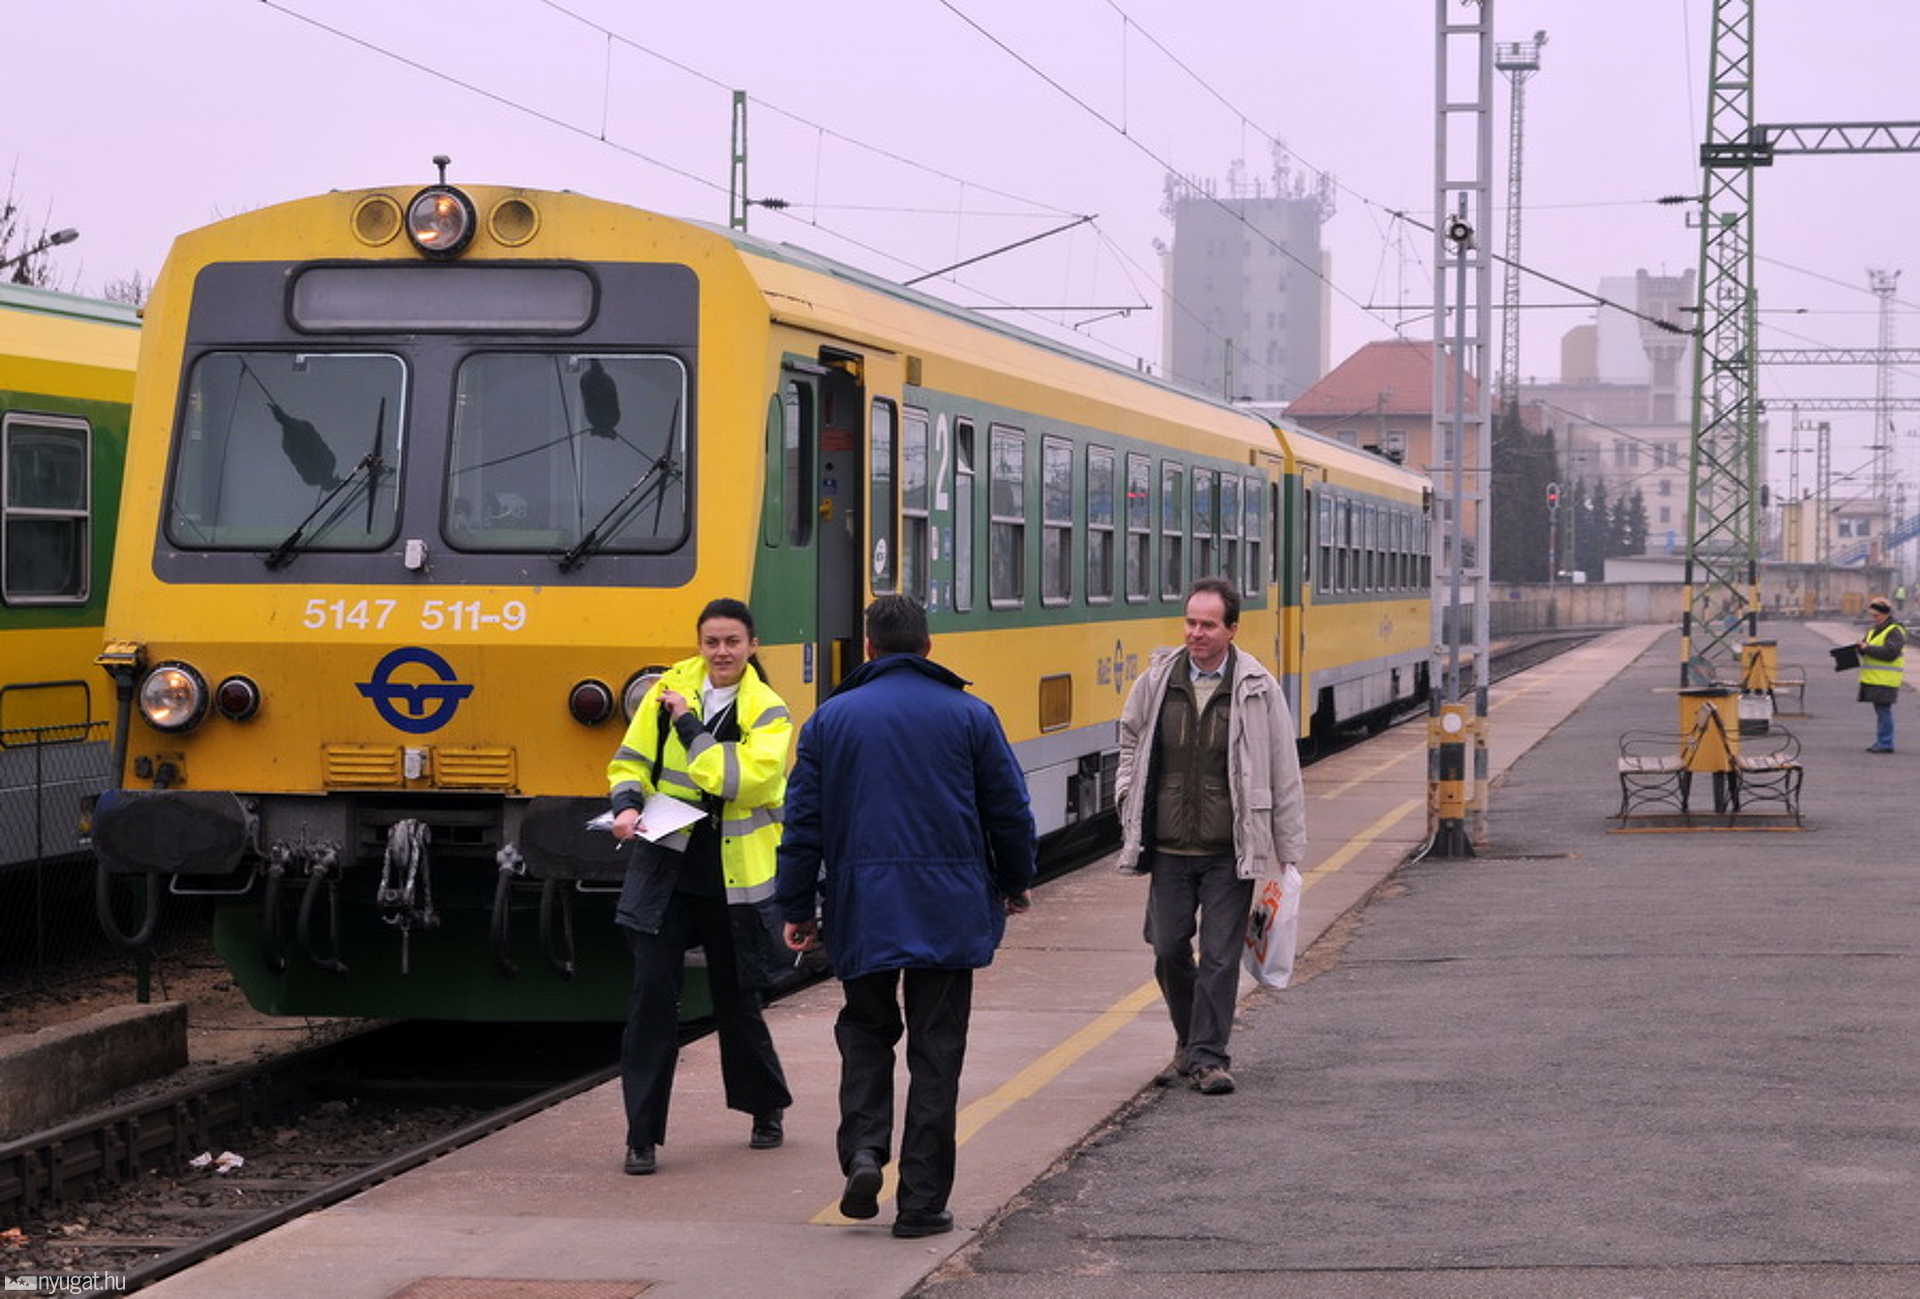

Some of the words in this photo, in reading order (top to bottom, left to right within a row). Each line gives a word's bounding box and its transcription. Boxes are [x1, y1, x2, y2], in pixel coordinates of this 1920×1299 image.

[934, 412, 949, 511] 2
[303, 599, 397, 630] 5147
[420, 600, 527, 631] 511-9
